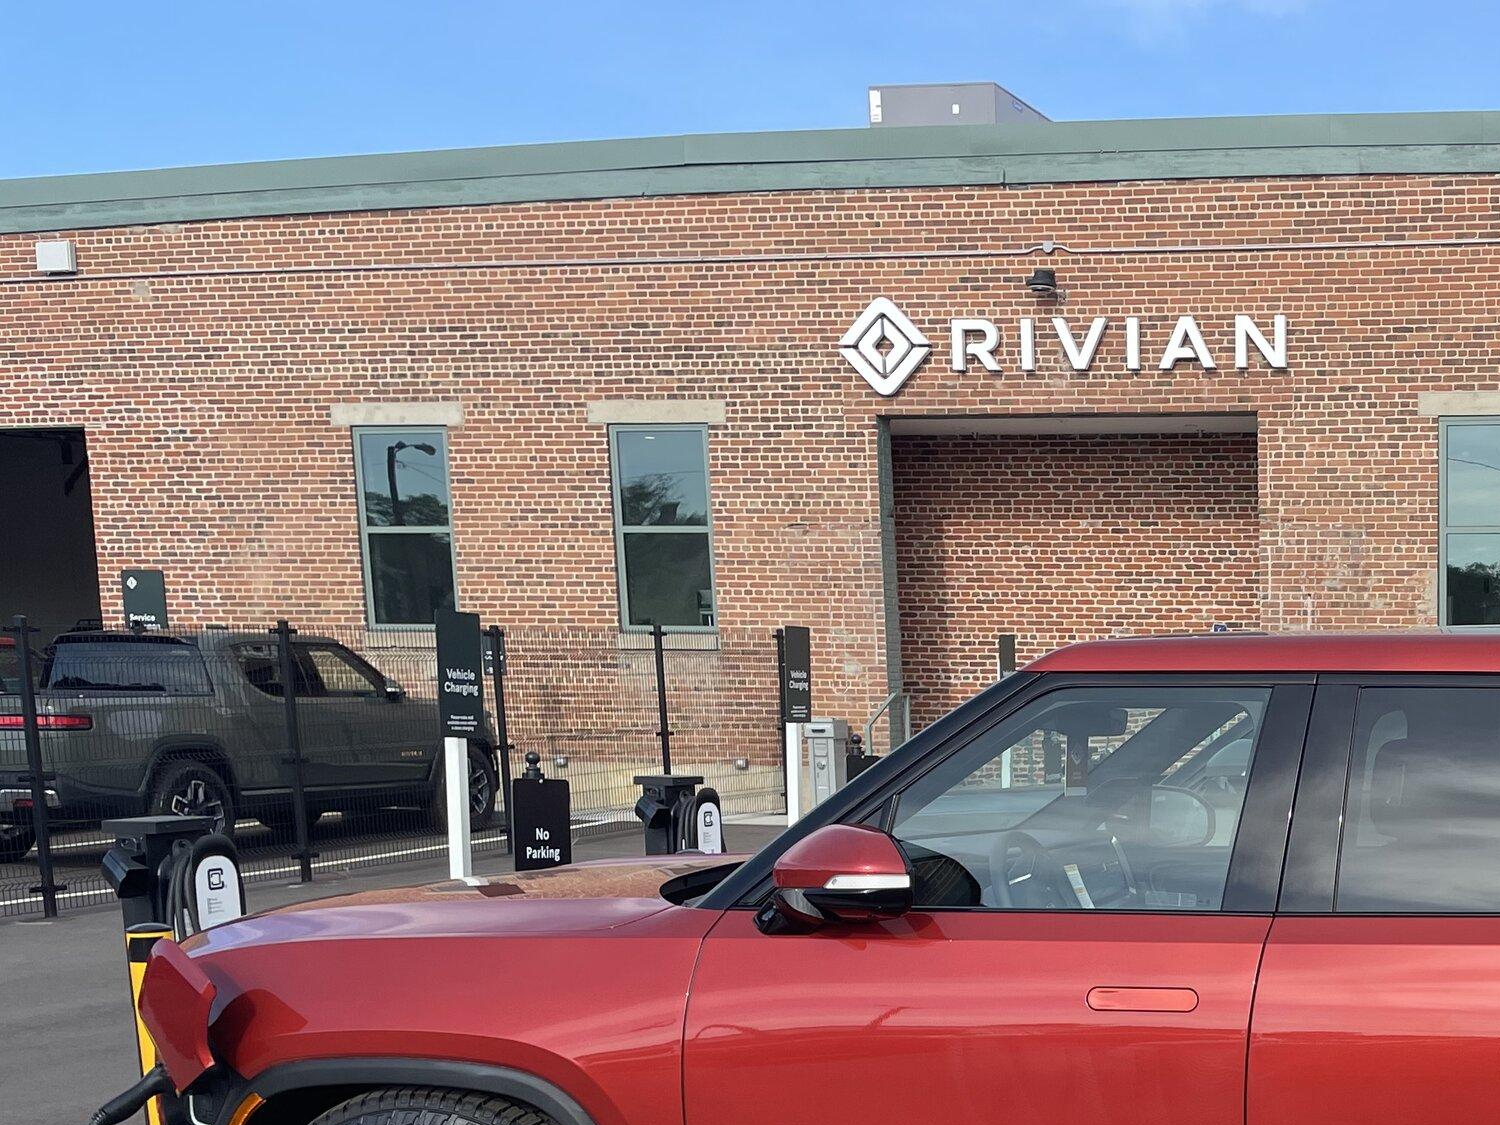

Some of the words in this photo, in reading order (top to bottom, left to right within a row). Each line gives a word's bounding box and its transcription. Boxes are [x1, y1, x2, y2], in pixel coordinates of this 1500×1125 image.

[950, 314, 1288, 371] RIVIAN
[445, 667, 476, 681] Vehicle
[789, 670, 808, 679] Vehicle
[444, 681, 479, 696] Charging
[535, 827, 550, 841] No
[526, 845, 561, 862] Parking
